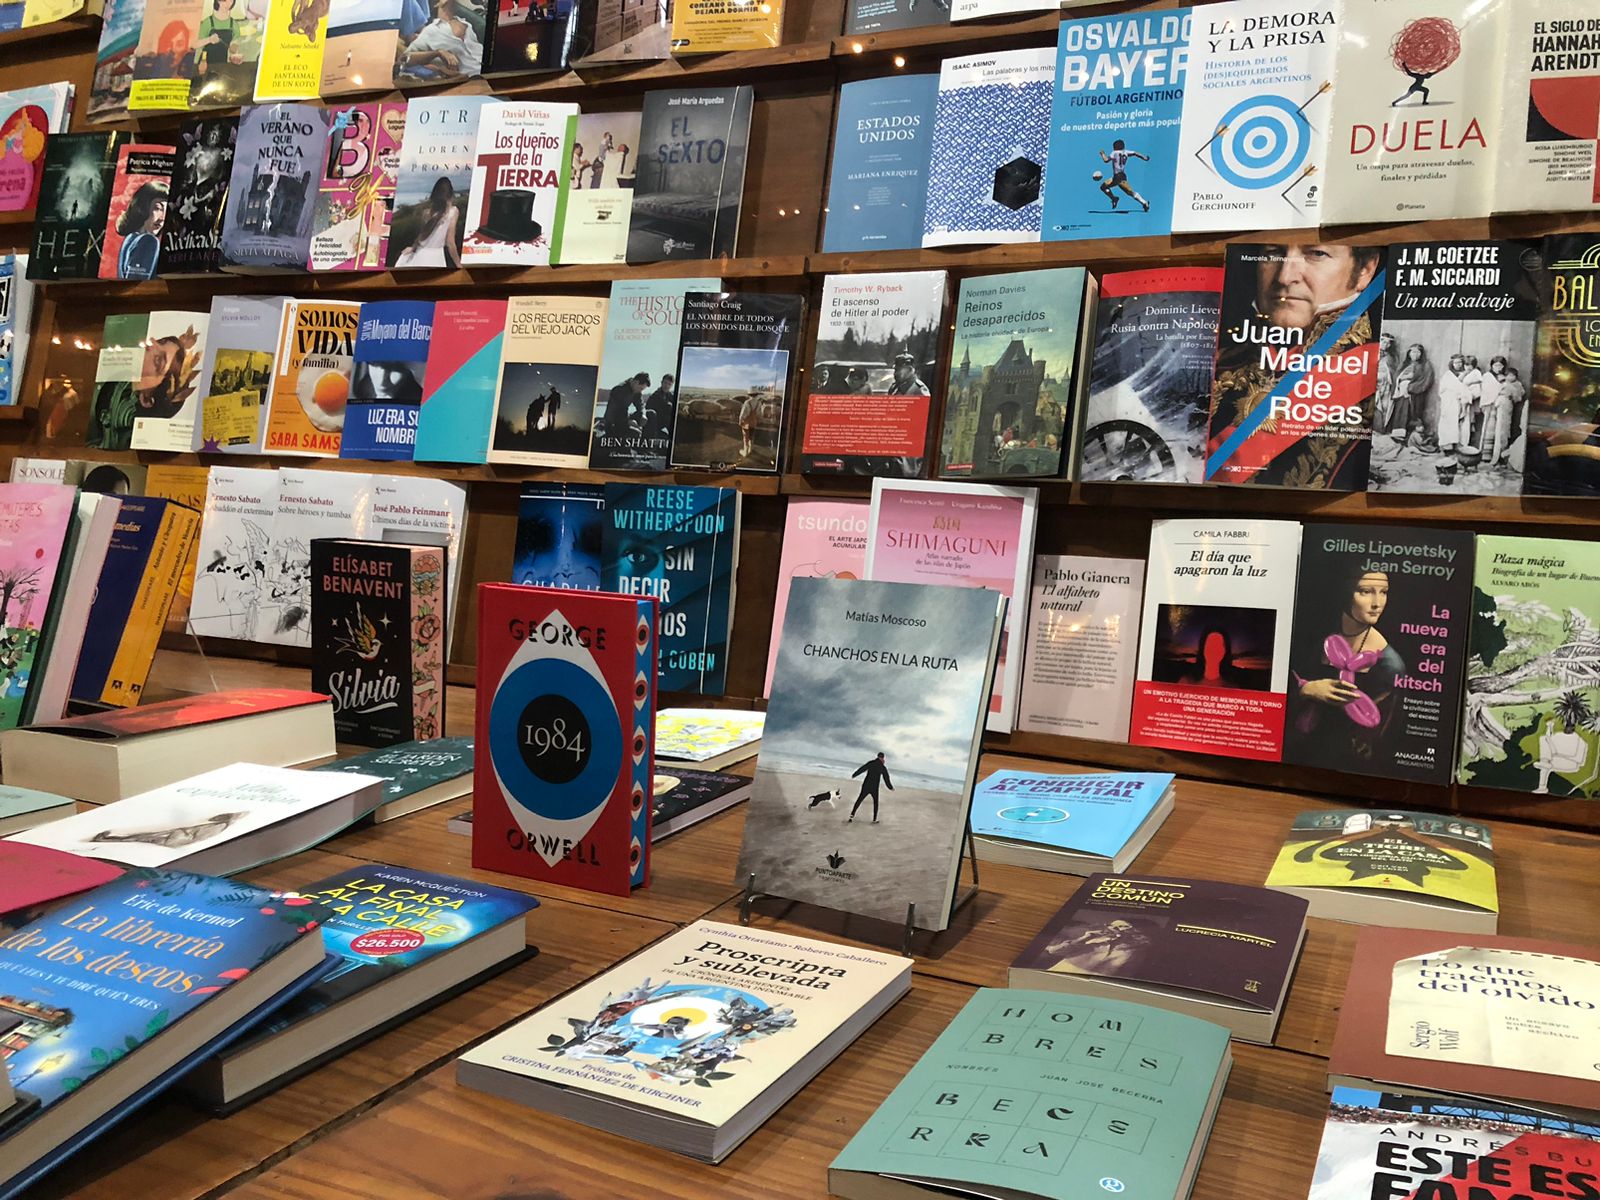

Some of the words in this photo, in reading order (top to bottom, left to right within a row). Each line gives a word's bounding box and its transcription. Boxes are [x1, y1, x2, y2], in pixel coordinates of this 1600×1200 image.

[1243, 11, 1336, 33] DEMORA
[1534, 21, 1547, 34] EL
[1551, 20, 1584, 33] SIGLO
[1208, 41, 1222, 53] Y
[1229, 36, 1255, 51] LA
[1264, 29, 1326, 48] PRISA
[1533, 35, 1600, 53] HANNAH
[952, 62, 970, 71] ISAAC
[972, 60, 997, 68] ASIMOV
[995, 66, 1020, 76] palabras
[1531, 53, 1600, 72] ARENDT
[1202, 80, 1247, 90] SOCIALES
[1250, 74, 1312, 85] ARGENTINOS
[698, 96, 725, 105] Arguedas
[1070, 93, 1113, 107] FÚTBOL
[1115, 89, 1183, 105] ARGENTINO
[502, 110, 526, 119] David
[857, 114, 920, 130] ESTADOS
[1096, 110, 1121, 120] Pasión
[1129, 109, 1153, 119] gloria
[261, 121, 313, 136] VERANO
[671, 116, 692, 137] EL
[1073, 122, 1102, 131] nuestro
[1104, 120, 1136, 131] deporte
[273, 135, 292, 144] QUE
[495, 131, 513, 149] Los
[516, 129, 559, 150] dueños
[859, 129, 915, 144] UNIDOS
[1350, 117, 1487, 155] DUELA
[258, 145, 304, 159] NUNCA
[514, 148, 529, 166] de
[531, 147, 542, 166] la
[658, 139, 726, 164] SEXTO
[269, 159, 296, 173] FUE
[848, 170, 880, 180] MARIANA
[477, 153, 559, 227] TIERRA
[1437, 247, 1499, 265] COETZEE
[1431, 269, 1500, 286] SICCARDI
[834, 285, 863, 294] Timothy
[877, 284, 903, 293] Ryback
[966, 289, 998, 298] Norman
[1000, 284, 1026, 295] Davies
[688, 300, 719, 310] Santiago
[720, 301, 742, 311] Craig
[843, 298, 879, 306] ascenso
[965, 300, 1002, 313] Reinos
[1145, 305, 1188, 317] Dominic
[1395, 292, 1418, 309] Un
[1422, 292, 1454, 309] mal
[1457, 293, 1515, 312] salvaje
[298, 310, 358, 329] SOMOS
[513, 313, 533, 323] LOS
[534, 313, 600, 325] RECUERDOS
[698, 314, 732, 322] NOMBRE
[831, 308, 842, 317] de
[844, 308, 869, 317] Hitler
[871, 307, 880, 316] al
[882, 307, 909, 319] poder
[963, 310, 1045, 328] desaparecidos
[372, 319, 396, 344] Moyano
[511, 324, 530, 334] DEL
[532, 324, 561, 335] VIEJO
[562, 326, 591, 336] JACK
[702, 323, 737, 331] SONIDOS
[1111, 323, 1136, 333] Rusia
[1138, 321, 1169, 332] contra
[1232, 319, 1303, 345] Juan
[298, 330, 355, 356] VIDA
[1260, 348, 1368, 375] Manuel
[1294, 376, 1332, 399] de
[1270, 396, 1363, 425] Rosas
[279, 494, 307, 505] Ernesto
[308, 496, 334, 506] Sabato
[646, 488, 694, 510] REESE
[614, 509, 725, 533] WITHERSPOON
[886, 529, 1007, 557] SHIMAGUNI
[1323, 539, 1365, 553] Gilles
[1369, 541, 1457, 562] Lipovetsky
[332, 554, 393, 577] ELÍSABET
[665, 545, 695, 571] SIN
[1190, 551, 1203, 562] El
[1205, 550, 1225, 563] día
[1228, 553, 1251, 565] que
[1493, 553, 1524, 566] Plaza
[1526, 555, 1565, 569] mágica
[1044, 568, 1078, 582] Pablo
[1081, 571, 1130, 585] Gianera
[1174, 565, 1228, 577] apagaron
[1232, 565, 1243, 577] la
[1247, 566, 1268, 578] luz
[1361, 558, 1398, 573] Jean
[1402, 560, 1455, 580] Serroy
[1491, 567, 1525, 578] Biografía
[323, 574, 403, 600] BENAVENT
[1056, 585, 1100, 600] alfabeto
[1040, 600, 1082, 613] natural
[1431, 604, 1450, 620] La
[845, 610, 879, 624] Matías
[881, 614, 927, 627] Moscoso
[508, 618, 606, 650] GEORGE
[1400, 623, 1448, 638] nueva
[803, 644, 878, 663] CHANCHOS
[880, 651, 898, 665] EN
[901, 653, 918, 667] LA
[921, 654, 959, 671] RUTA
[1420, 643, 1446, 656] era
[669, 650, 715, 672] COBEN
[1418, 660, 1445, 674] del
[329, 668, 401, 714] Silvia
[1393, 677, 1442, 692] kitsch
[1179, 692, 1209, 700] EJERCICIO
[1220, 695, 1248, 703] MEMORIA
[525, 718, 585, 762] 1984
[1395, 751, 1435, 762] ANAGRAMA
[999, 777, 1146, 790] CONDUCIR
[1020, 785, 1136, 800] CAPITAL
[506, 828, 600, 866] ORWELL
[1363, 843, 1426, 852] TIGRE
[375, 873, 414, 884] KAREN
[416, 879, 486, 898] MCQUESTION
[1097, 886, 1185, 900] DESTINO
[358, 892, 439, 920] FINAL
[389, 888, 465, 910] CASA
[362, 910, 456, 937] CALLE
[101, 913, 225, 960] librería
[356, 938, 420, 948] $26.500
[1175, 927, 1227, 937] LUCRECIA
[1228, 934, 1274, 948] MARTEL
[699, 927, 739, 940] Cynthia
[739, 934, 787, 949] Ottaviano
[793, 943, 831, 958] Roberto
[832, 951, 888, 966] Caballero
[694, 941, 848, 979] Proscripta
[85, 951, 203, 994] deseos
[698, 956, 831, 991] sublevada
[1419, 969, 1562, 993] traemos
[1481, 983, 1596, 1010] olvido
[1410, 1020, 1434, 1049] Sergio
[1439, 1028, 1460, 1050] Wolf
[501, 1053, 550, 1070] CRISTINA
[551, 1063, 620, 1086] FERNÁNDEZ
[638, 1085, 701, 1107] KIRCHNER
[1039, 1073, 1069, 1083] JUAN
[1112, 1086, 1165, 1105] BECERRA
[1379, 1127, 1530, 1156] ANDRÉS
[1376, 1141, 1513, 1188] ESTE
